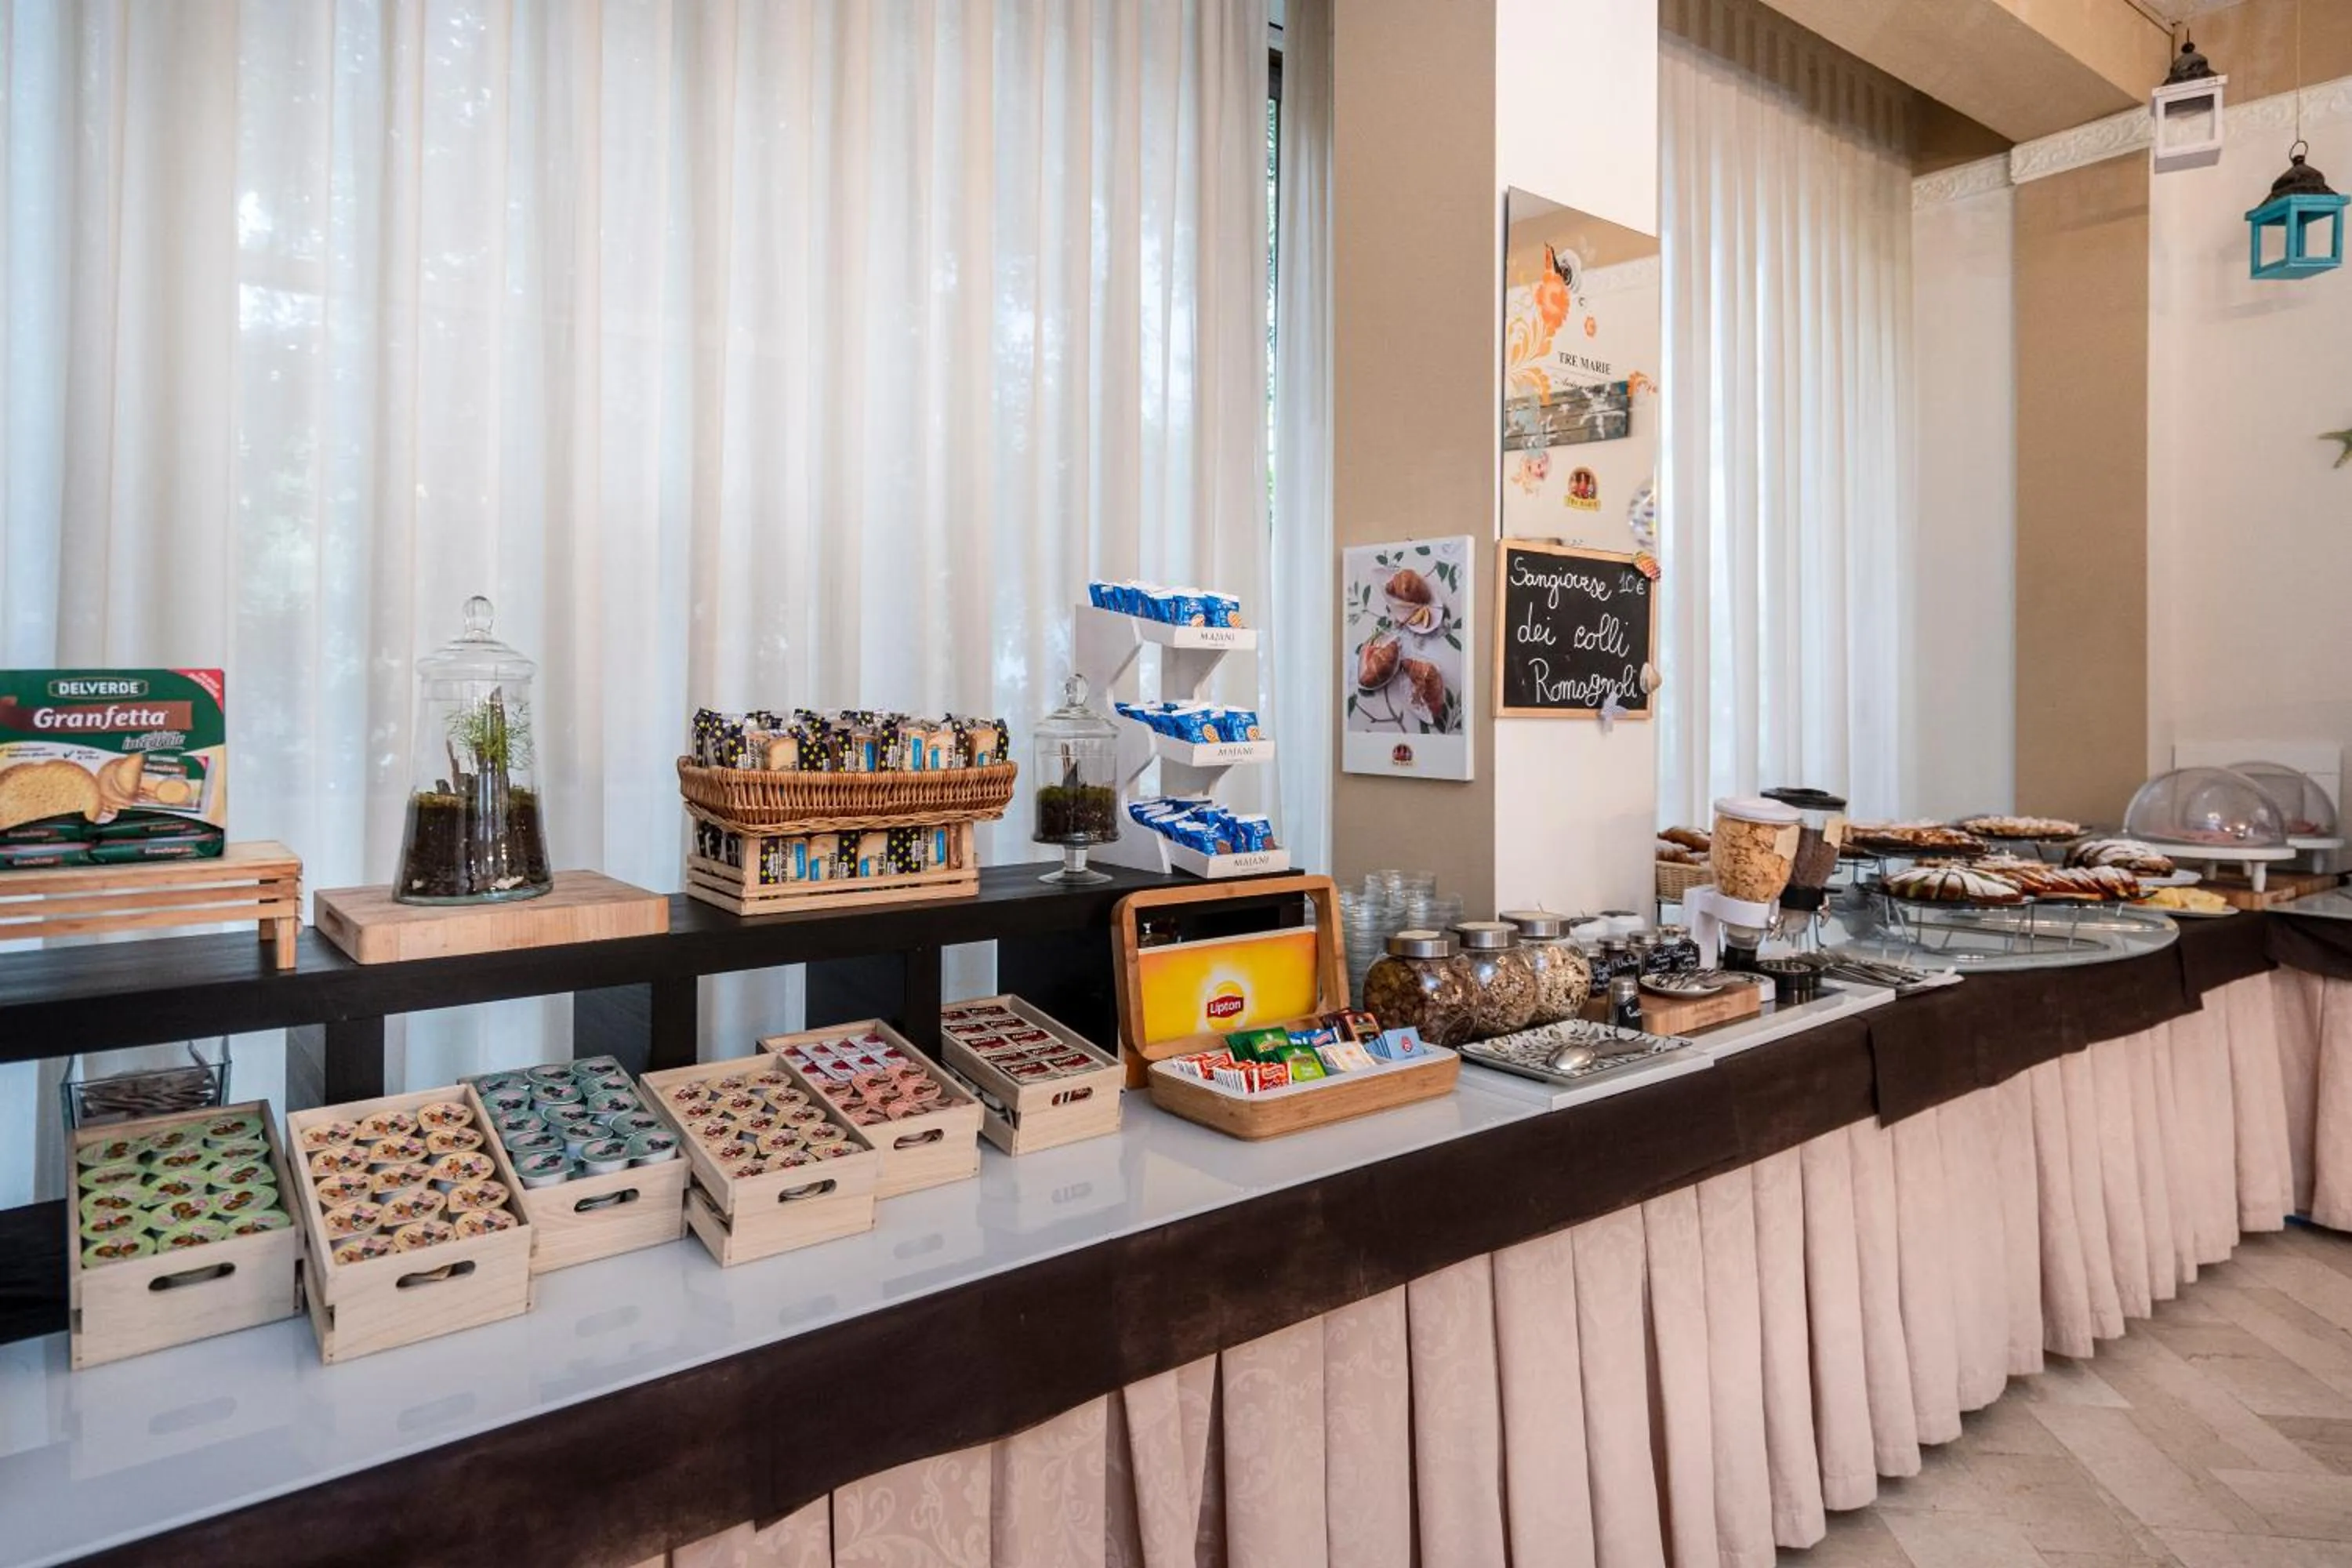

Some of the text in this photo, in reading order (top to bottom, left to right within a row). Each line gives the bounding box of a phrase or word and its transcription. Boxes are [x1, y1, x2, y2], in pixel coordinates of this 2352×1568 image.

[1558, 350, 1611, 375] TRE MARIE
[1511, 557, 1612, 609] Sangiovese
[1518, 602, 1630, 657] dei colli
[59, 681, 139, 695] DELVERDE
[1529, 658, 1638, 706] Romagnoli
[34, 706, 165, 728] Granfetta
[1210, 1000, 1240, 1014] Lipton
